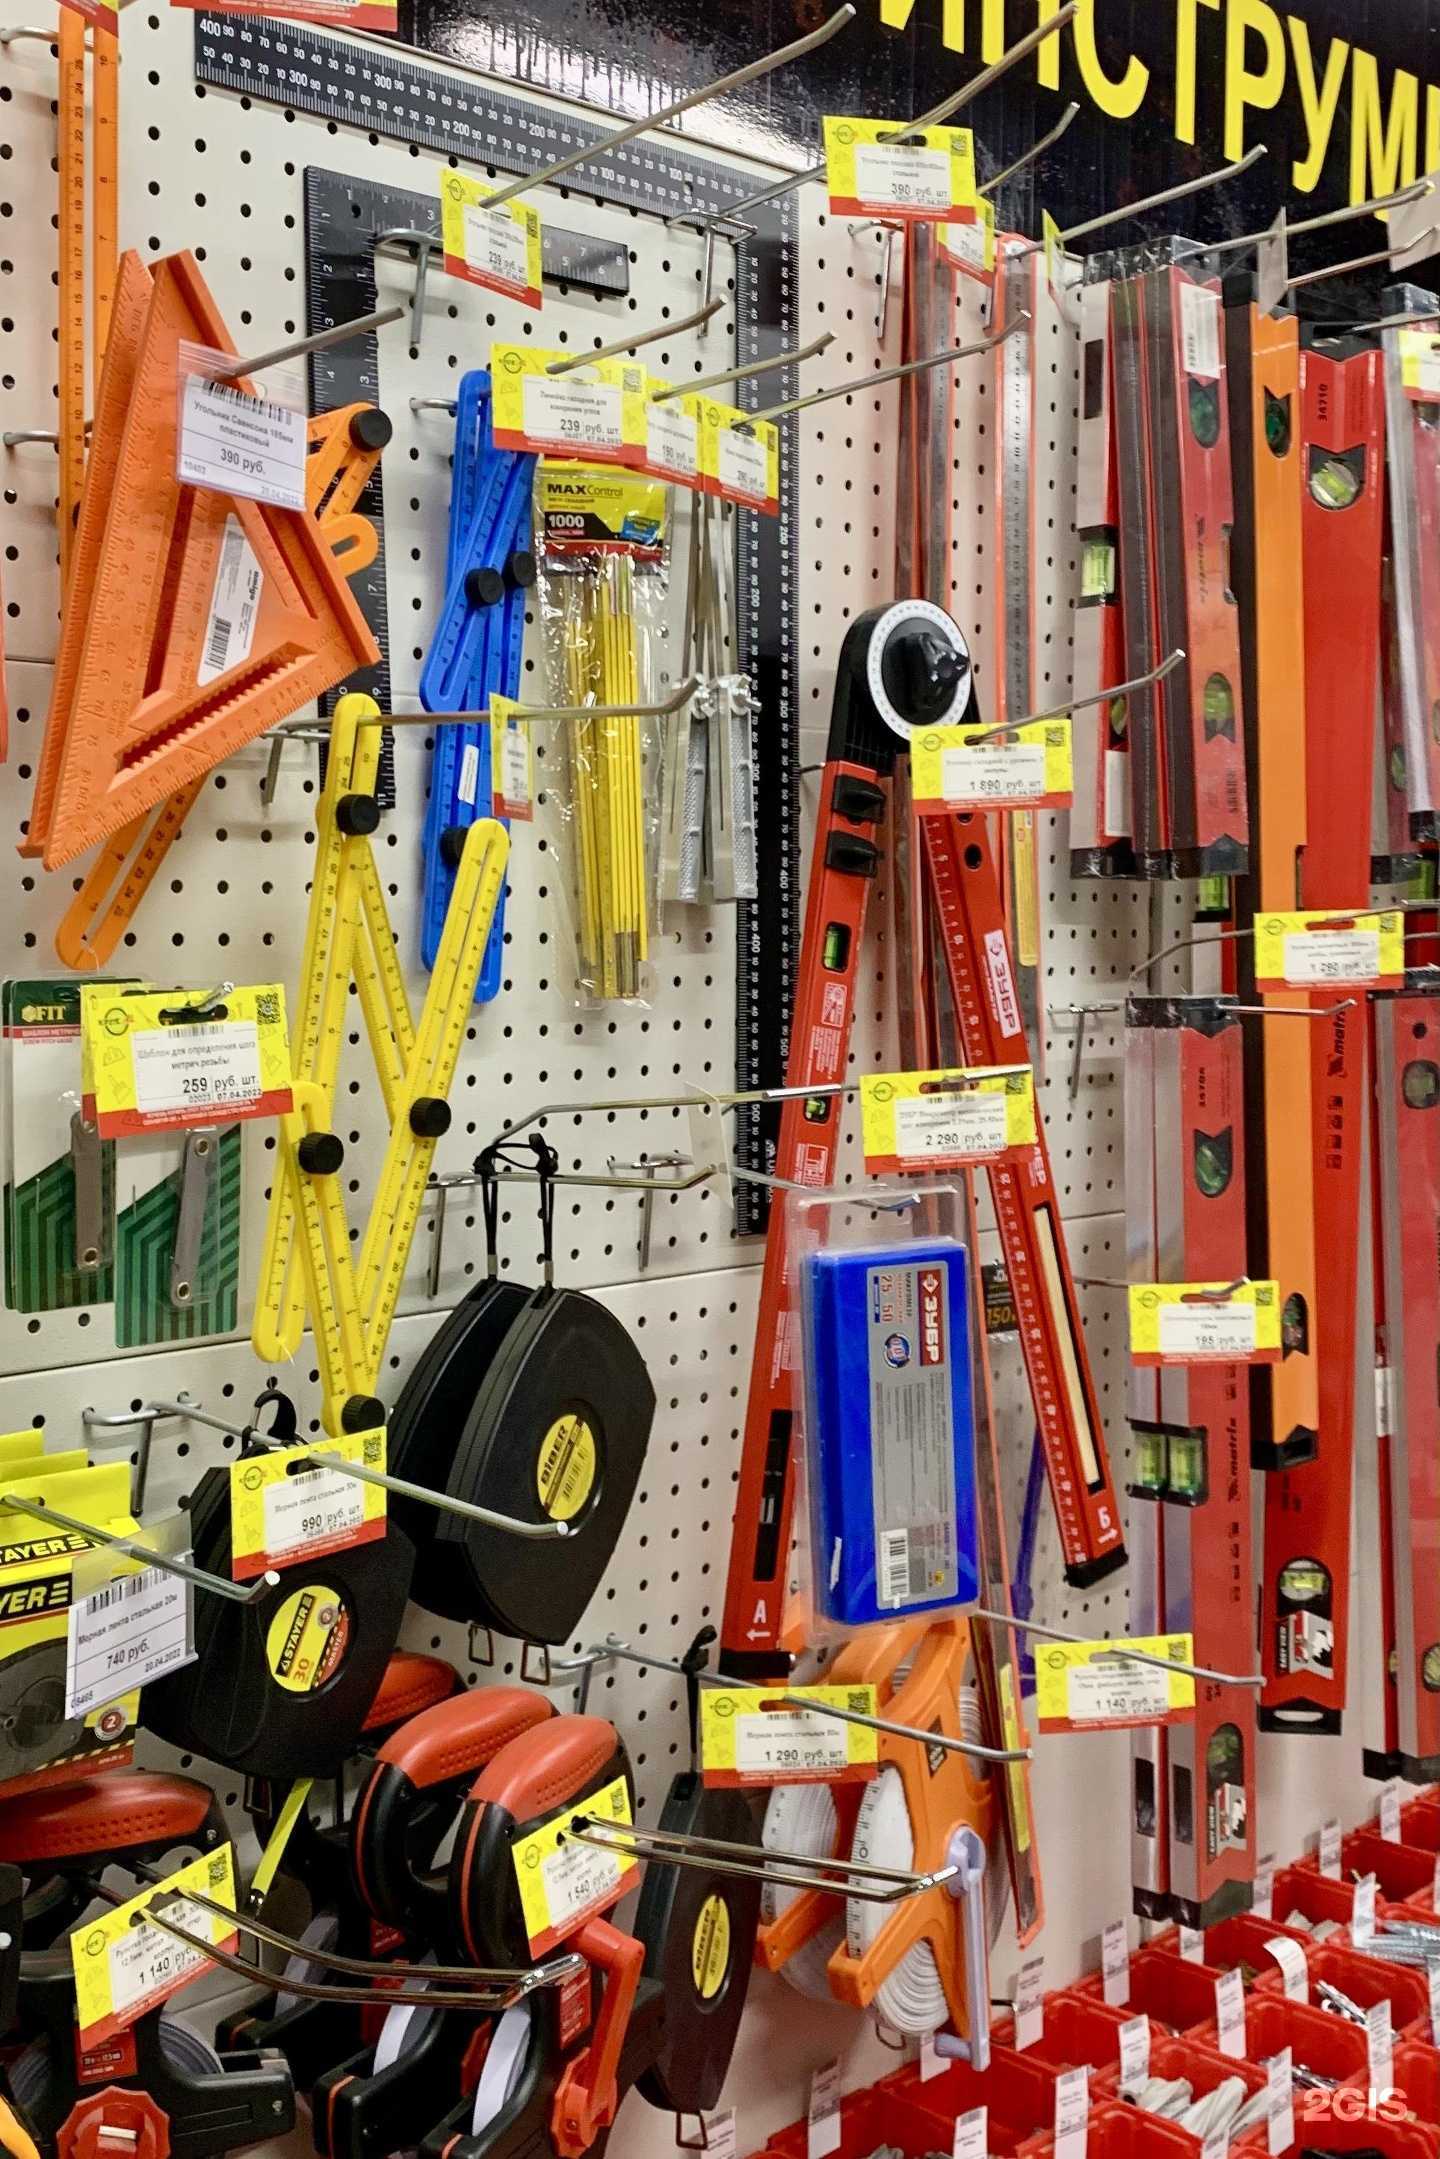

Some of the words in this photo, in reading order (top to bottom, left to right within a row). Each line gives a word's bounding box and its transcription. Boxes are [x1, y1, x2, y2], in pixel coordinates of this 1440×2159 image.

[560, 419, 580, 432] 239
[220, 447, 240, 467] 390
[242, 455, 267, 475] руб.
[548, 515, 585, 528] 1000
[994, 961, 1016, 1029] ЗУБР
[36, 1005, 66, 1021] FIT
[183, 1077, 208, 1094] 259
[937, 1133, 959, 1145] 290
[924, 1297, 941, 1362] ЗУБР
[302, 1515, 322, 1532] 990
[107, 1647, 126, 1669] 740
[777, 1750, 799, 1761] 290
[150, 1957, 170, 1978] 140
